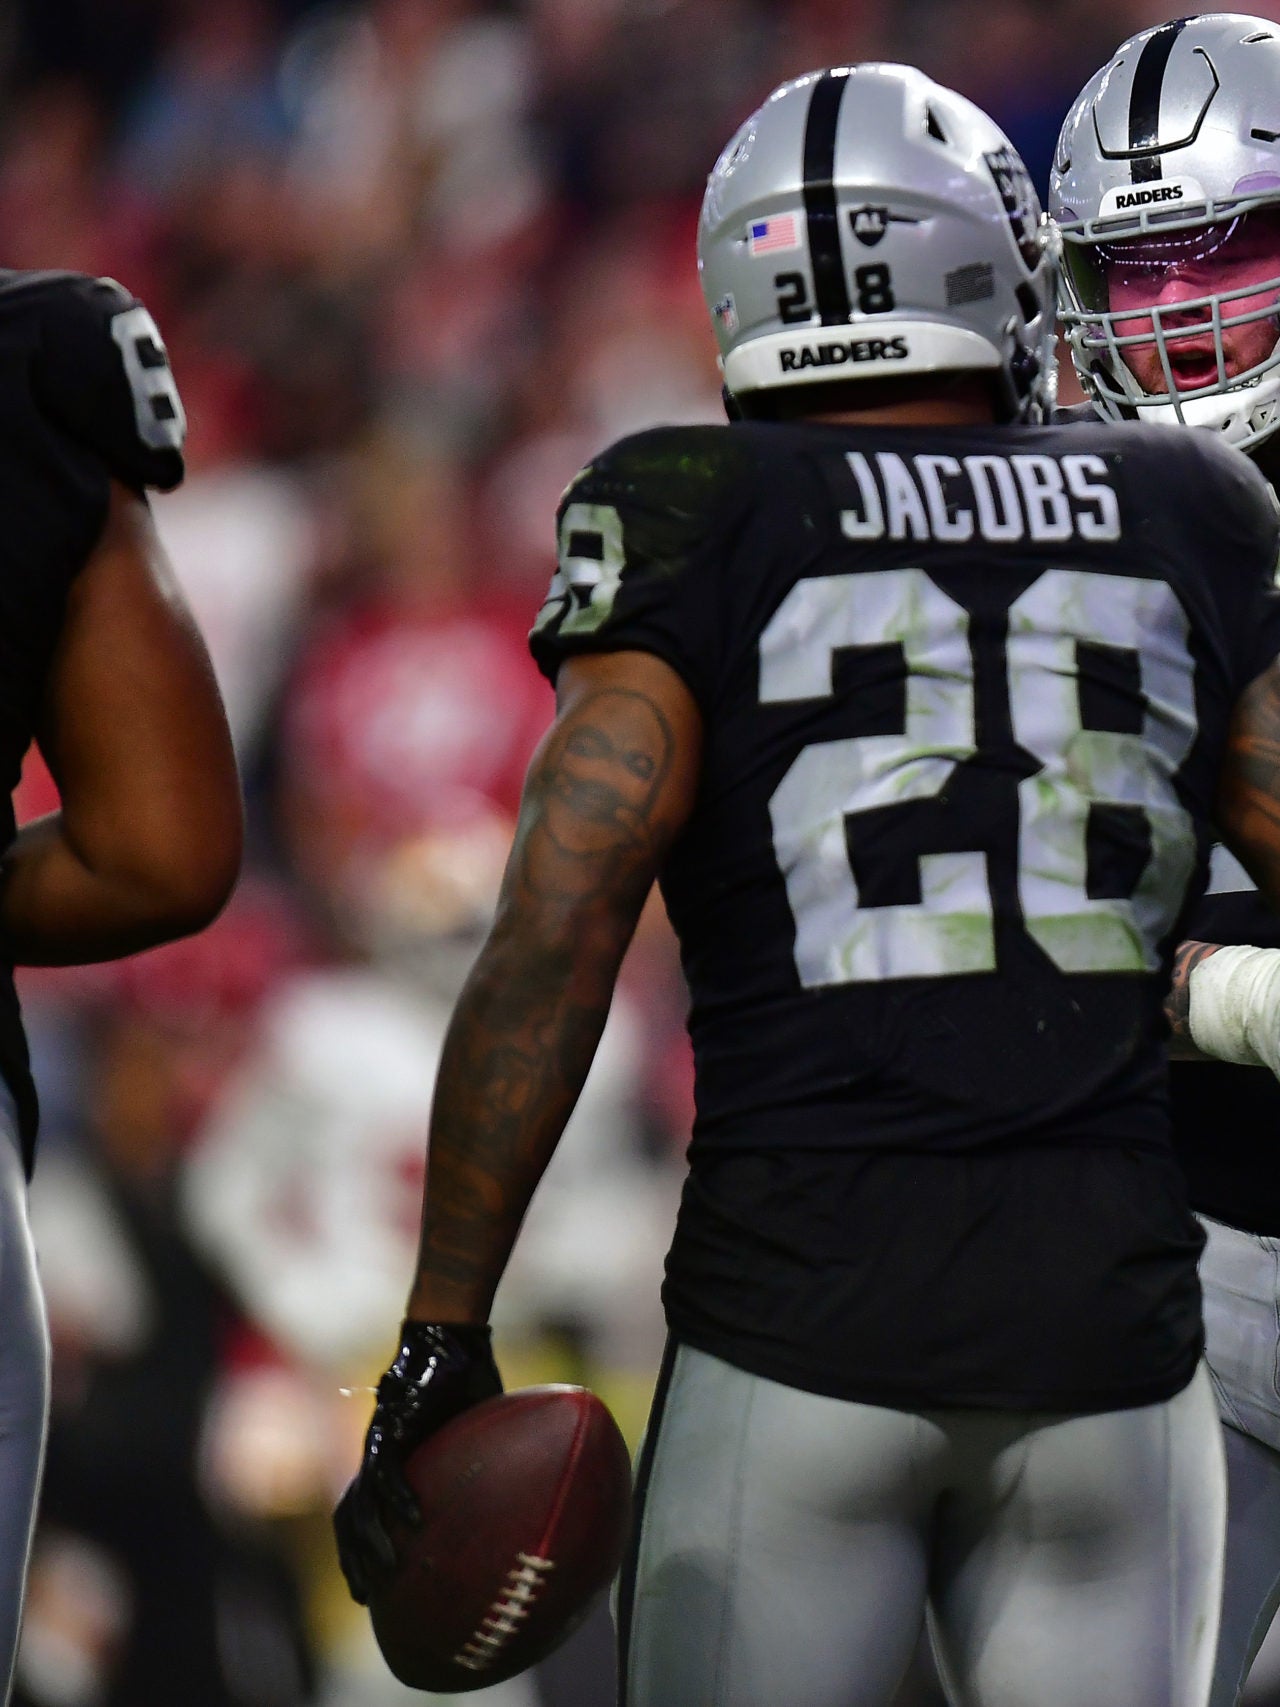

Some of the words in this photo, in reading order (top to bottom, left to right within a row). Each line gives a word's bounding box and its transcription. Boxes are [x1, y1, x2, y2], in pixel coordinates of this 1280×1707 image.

[1115, 185, 1183, 209] RAIDERS
[779, 336, 909, 372] RAIDERS
[839, 450, 1121, 541] JACOBS
[758, 567, 1197, 988] 28
